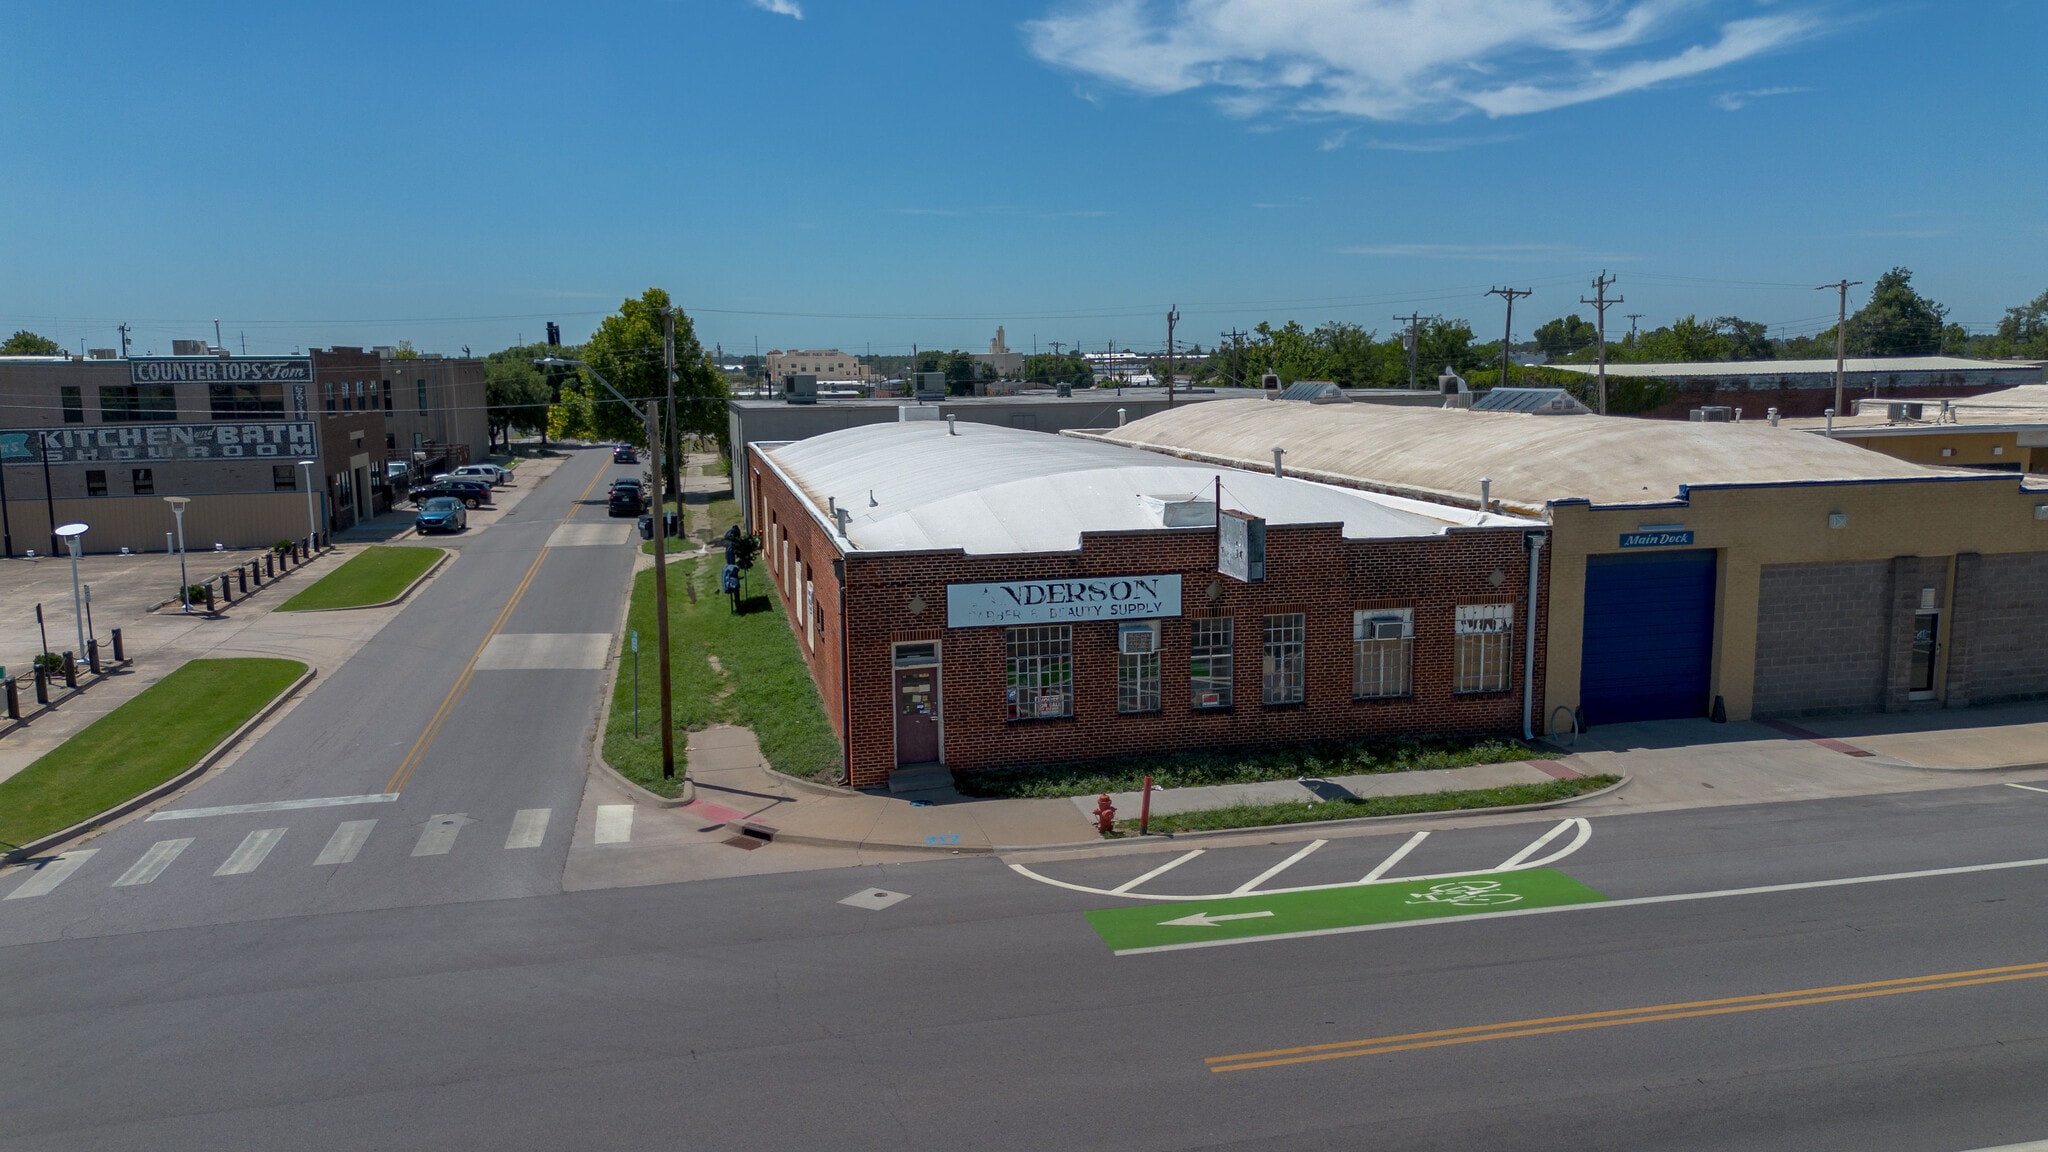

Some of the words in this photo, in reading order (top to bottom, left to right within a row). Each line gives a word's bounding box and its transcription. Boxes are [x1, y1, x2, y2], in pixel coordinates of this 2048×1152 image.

[137, 362, 217, 381] COUNTER
[218, 362, 262, 380] TOPS
[267, 362, 305, 379] Tom
[38, 427, 194, 448] KITCHEN
[194, 425, 217, 438] and
[216, 425, 311, 444] BATH
[1624, 534, 1658, 546] Main
[1659, 533, 1688, 545] Dock
[982, 579, 1159, 606] NDERSON
[1110, 602, 1162, 616] SUPPLY
